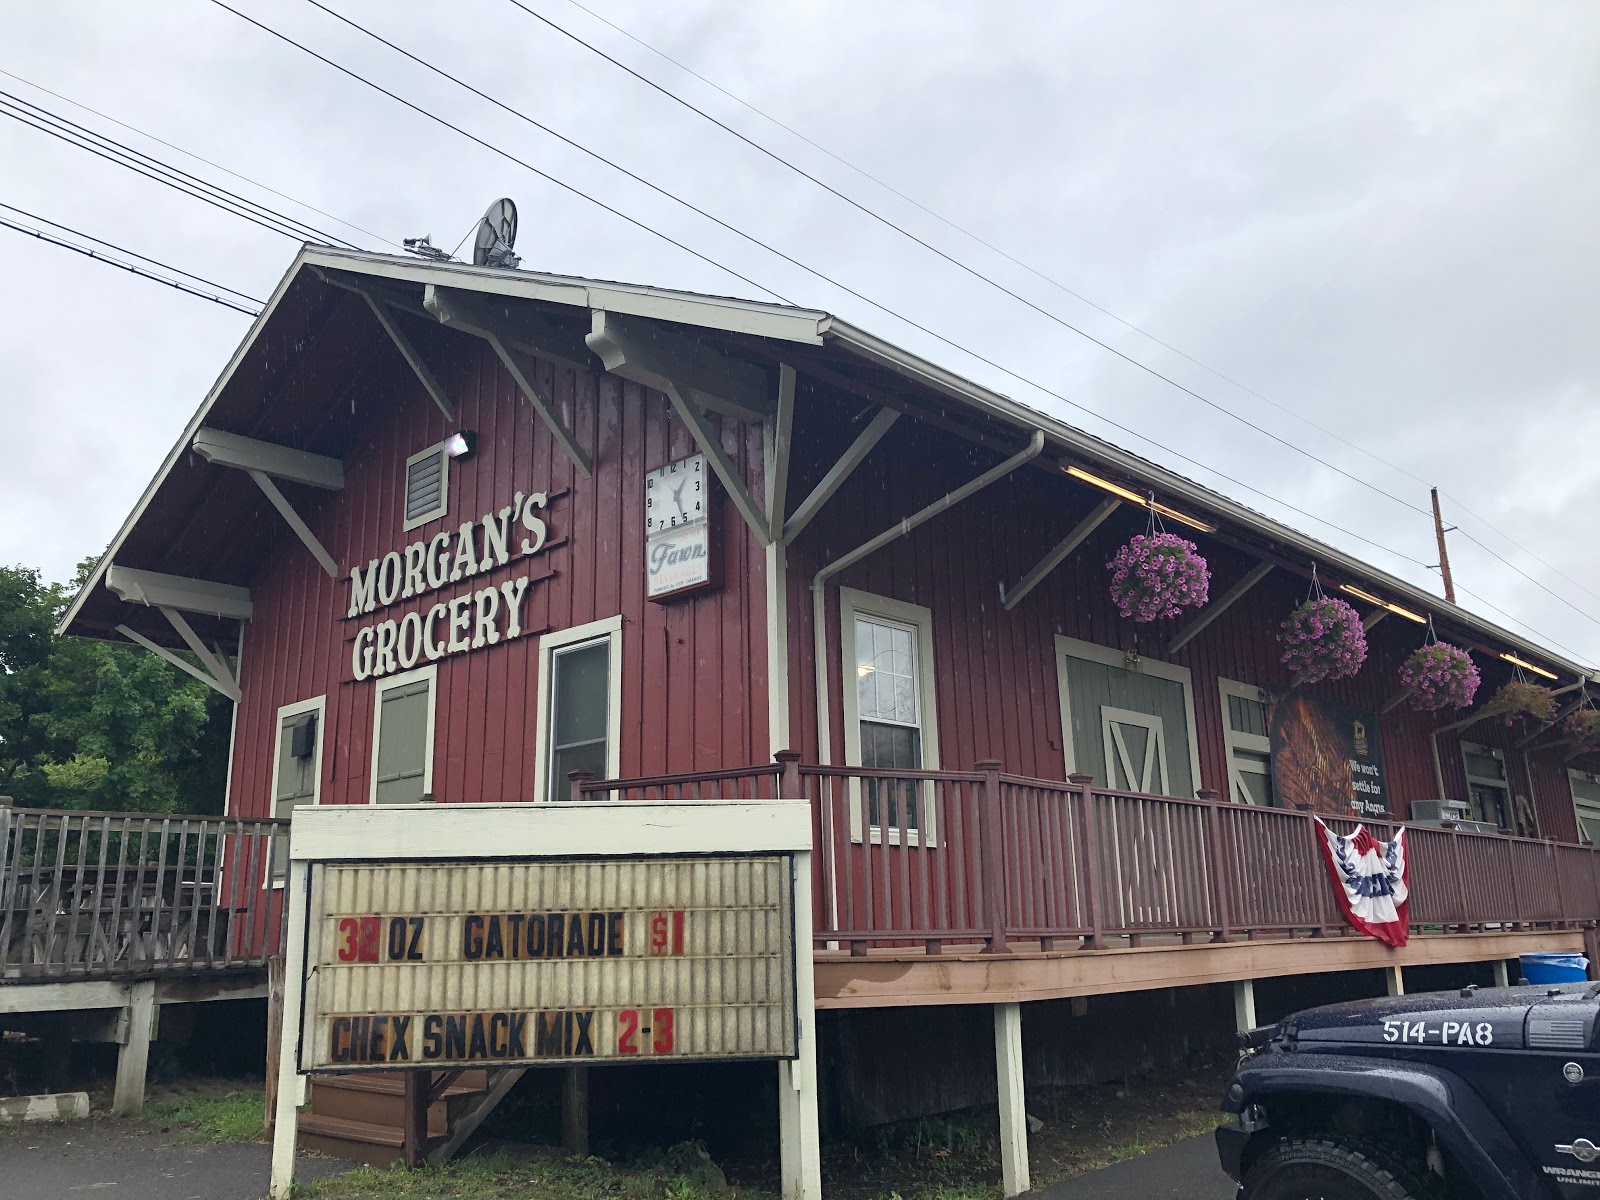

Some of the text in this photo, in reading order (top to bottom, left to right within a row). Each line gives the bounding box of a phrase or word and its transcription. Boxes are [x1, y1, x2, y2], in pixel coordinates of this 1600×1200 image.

[670, 462, 677, 473] 12
[694, 461, 700, 472] 2
[647, 478, 654, 489] 10
[694, 480, 700, 491] 3
[647, 497, 652, 508] 9
[695, 501, 701, 511] 4
[647, 512, 688, 531] 8 7 6 5
[348, 491, 547, 619] MORGAN'S
[650, 543, 706, 575] Fawn
[654, 563, 703, 585] BEVERAGES
[352, 576, 529, 682] GROCERY
[1349, 759, 1379, 776] We won't
[1352, 780, 1381, 794] settle for
[1351, 800, 1364, 813] any
[338, 910, 685, 962] 32 OZ GATORADE $1
[331, 1008, 674, 1062] CHEX SNACK MIX 2-3
[1382, 1021, 1493, 1046] 514-PA8
